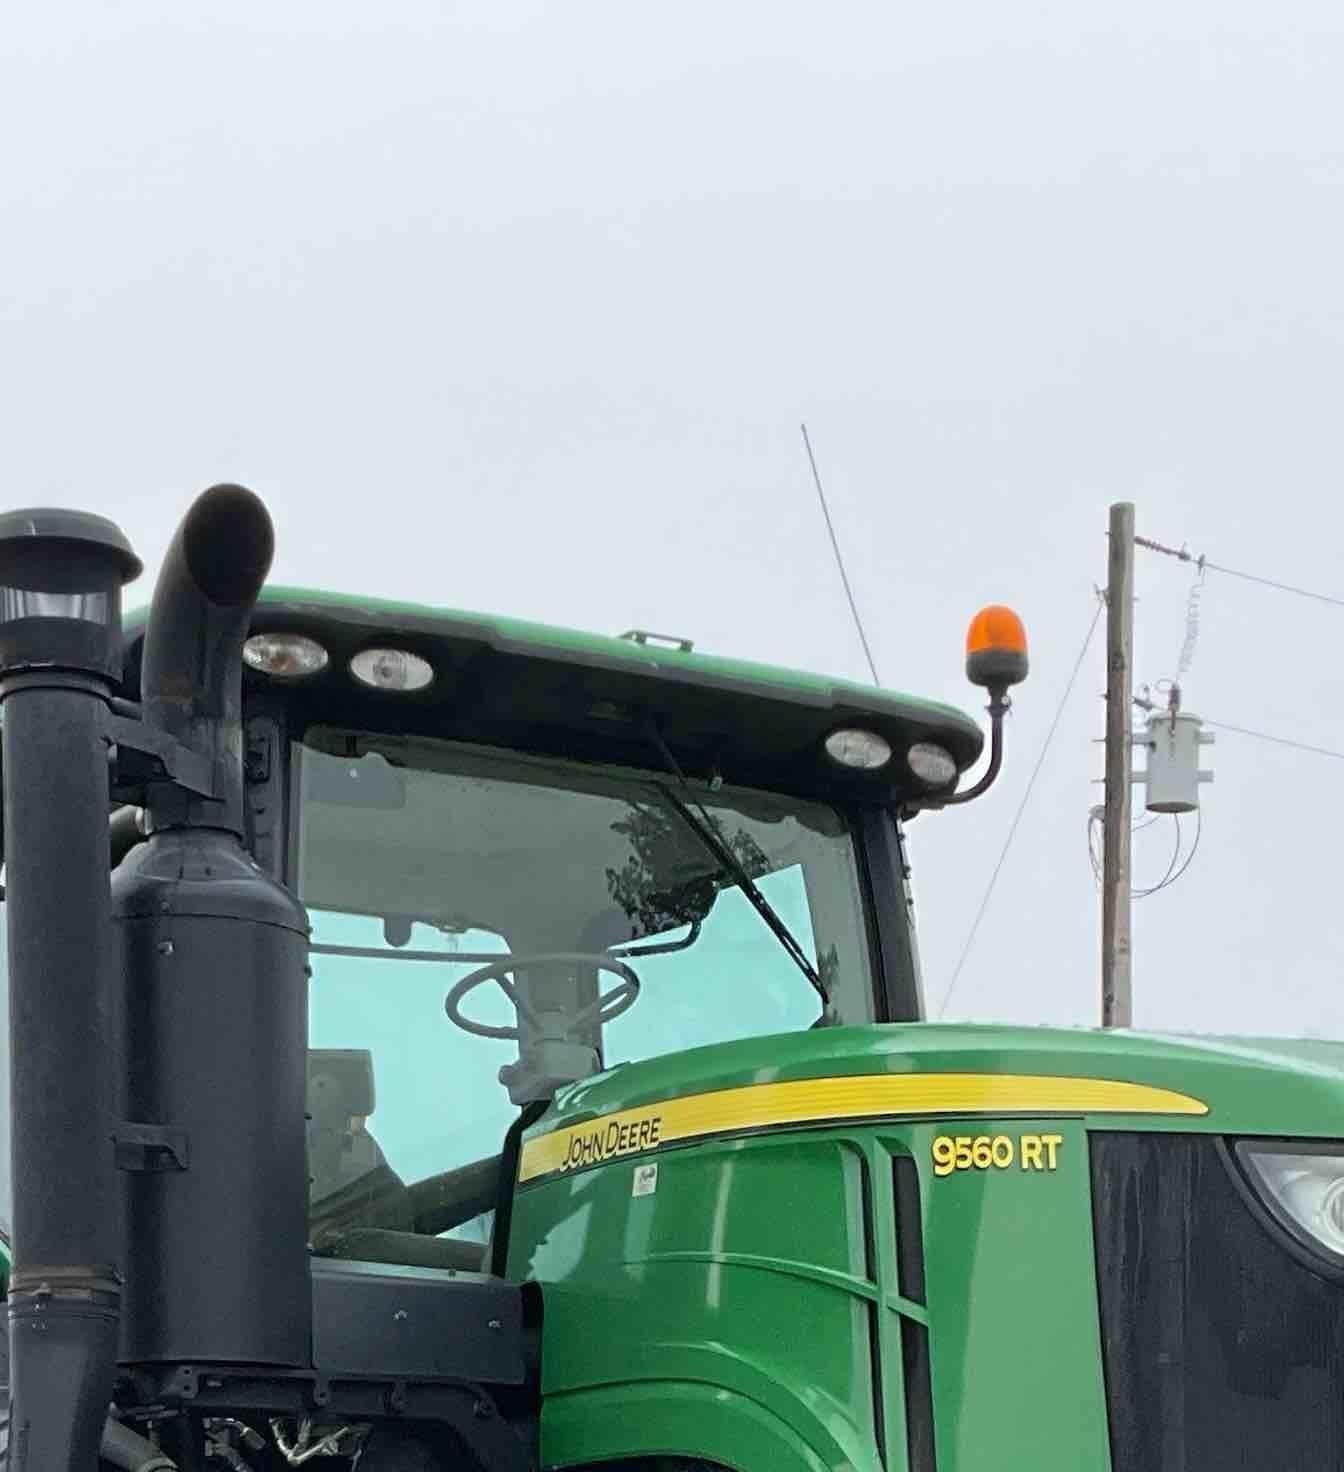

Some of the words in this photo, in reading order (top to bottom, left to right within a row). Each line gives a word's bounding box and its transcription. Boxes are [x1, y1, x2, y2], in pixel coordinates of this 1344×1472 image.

[561, 1131, 606, 1167] JOHN
[605, 1118, 661, 1155] DEERE
[932, 1135, 1014, 1176] 9560
[1020, 1135, 1063, 1169] RT
